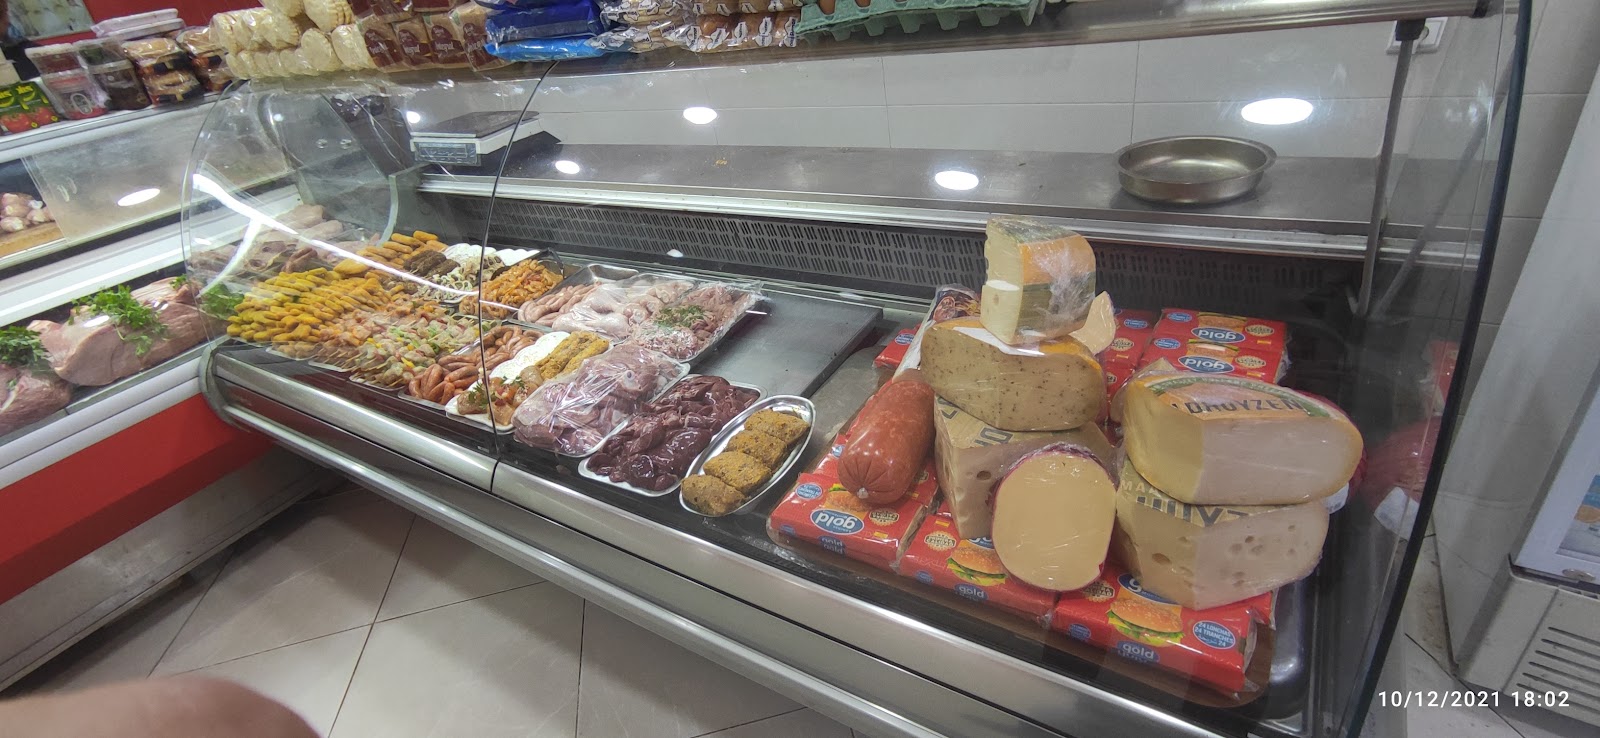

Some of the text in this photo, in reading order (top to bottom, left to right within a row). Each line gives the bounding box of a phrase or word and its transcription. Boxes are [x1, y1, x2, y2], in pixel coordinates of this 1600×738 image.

[1199, 329, 1237, 341] gold
[1184, 357, 1225, 371] gold
[816, 511, 858, 530] gold
[959, 585, 984, 598] gold
[1203, 629, 1235, 644] TRANCHES
[1122, 643, 1155, 660] gold
